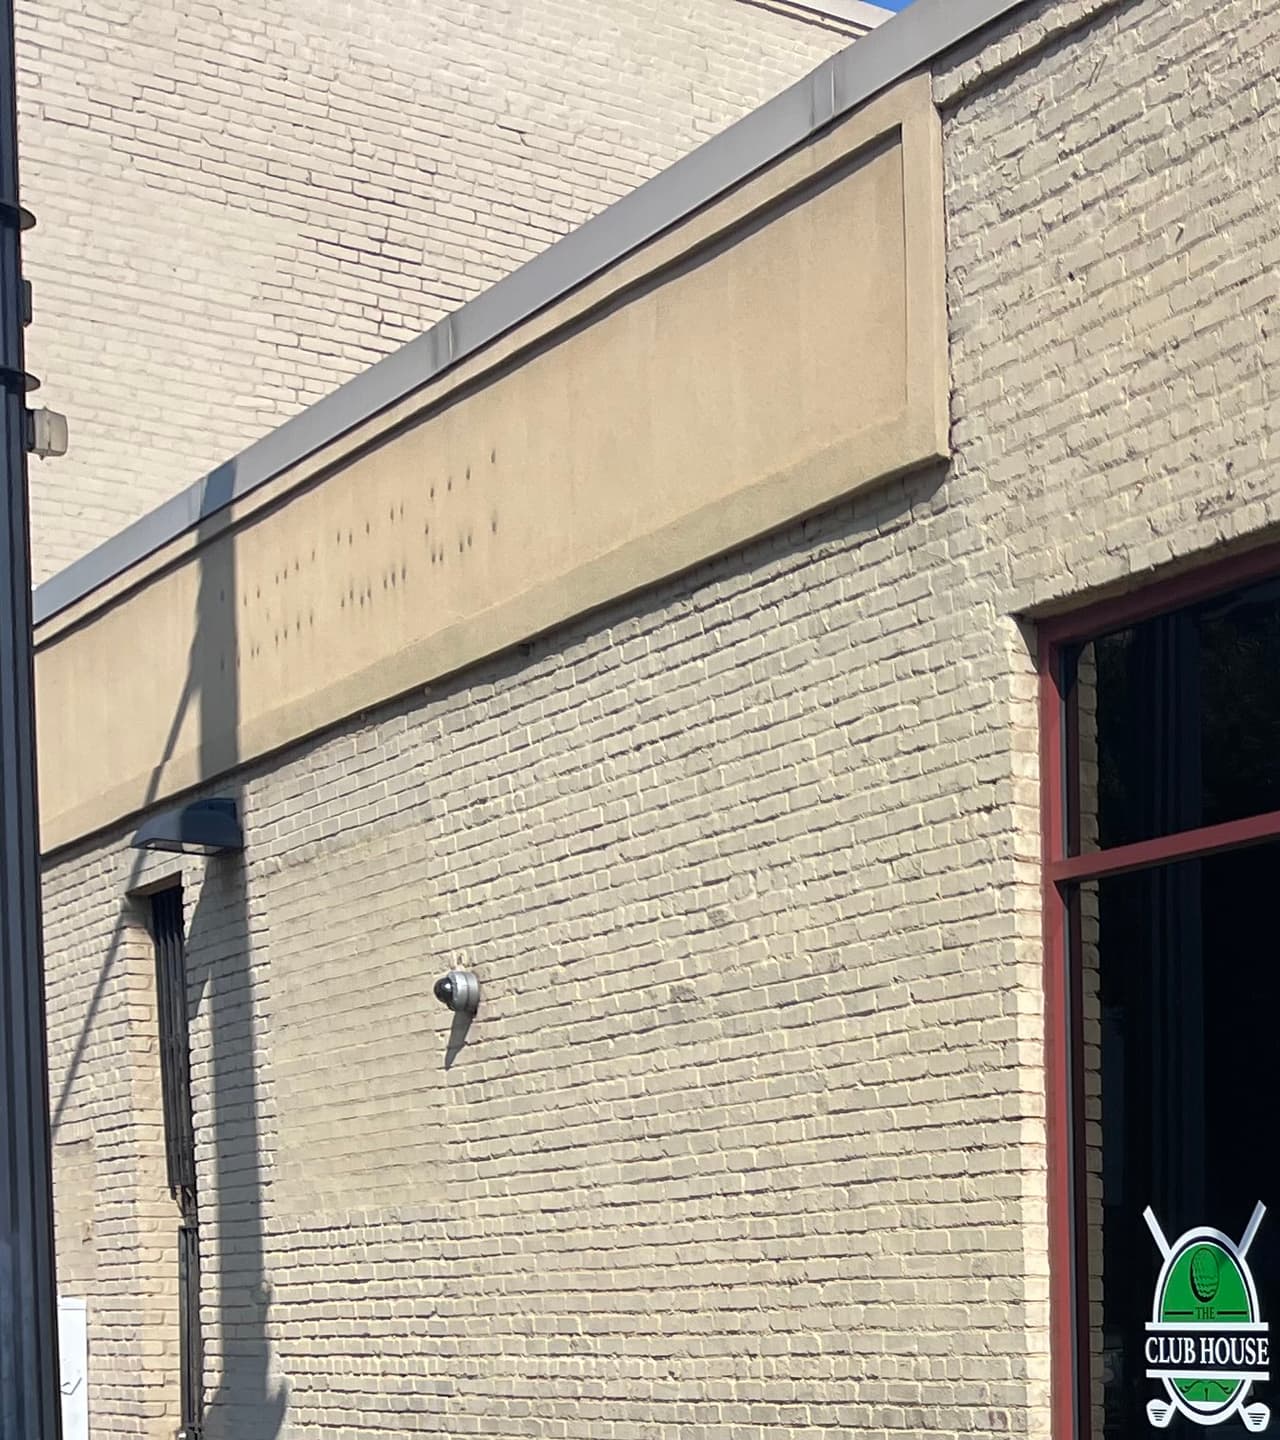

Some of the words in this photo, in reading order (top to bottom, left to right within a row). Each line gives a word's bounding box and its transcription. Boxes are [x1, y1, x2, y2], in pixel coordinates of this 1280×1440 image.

[1195, 1306, 1215, 1319] THE
[1144, 1336, 1197, 1364] CLUB
[1199, 1336, 1269, 1365] HOUSE
